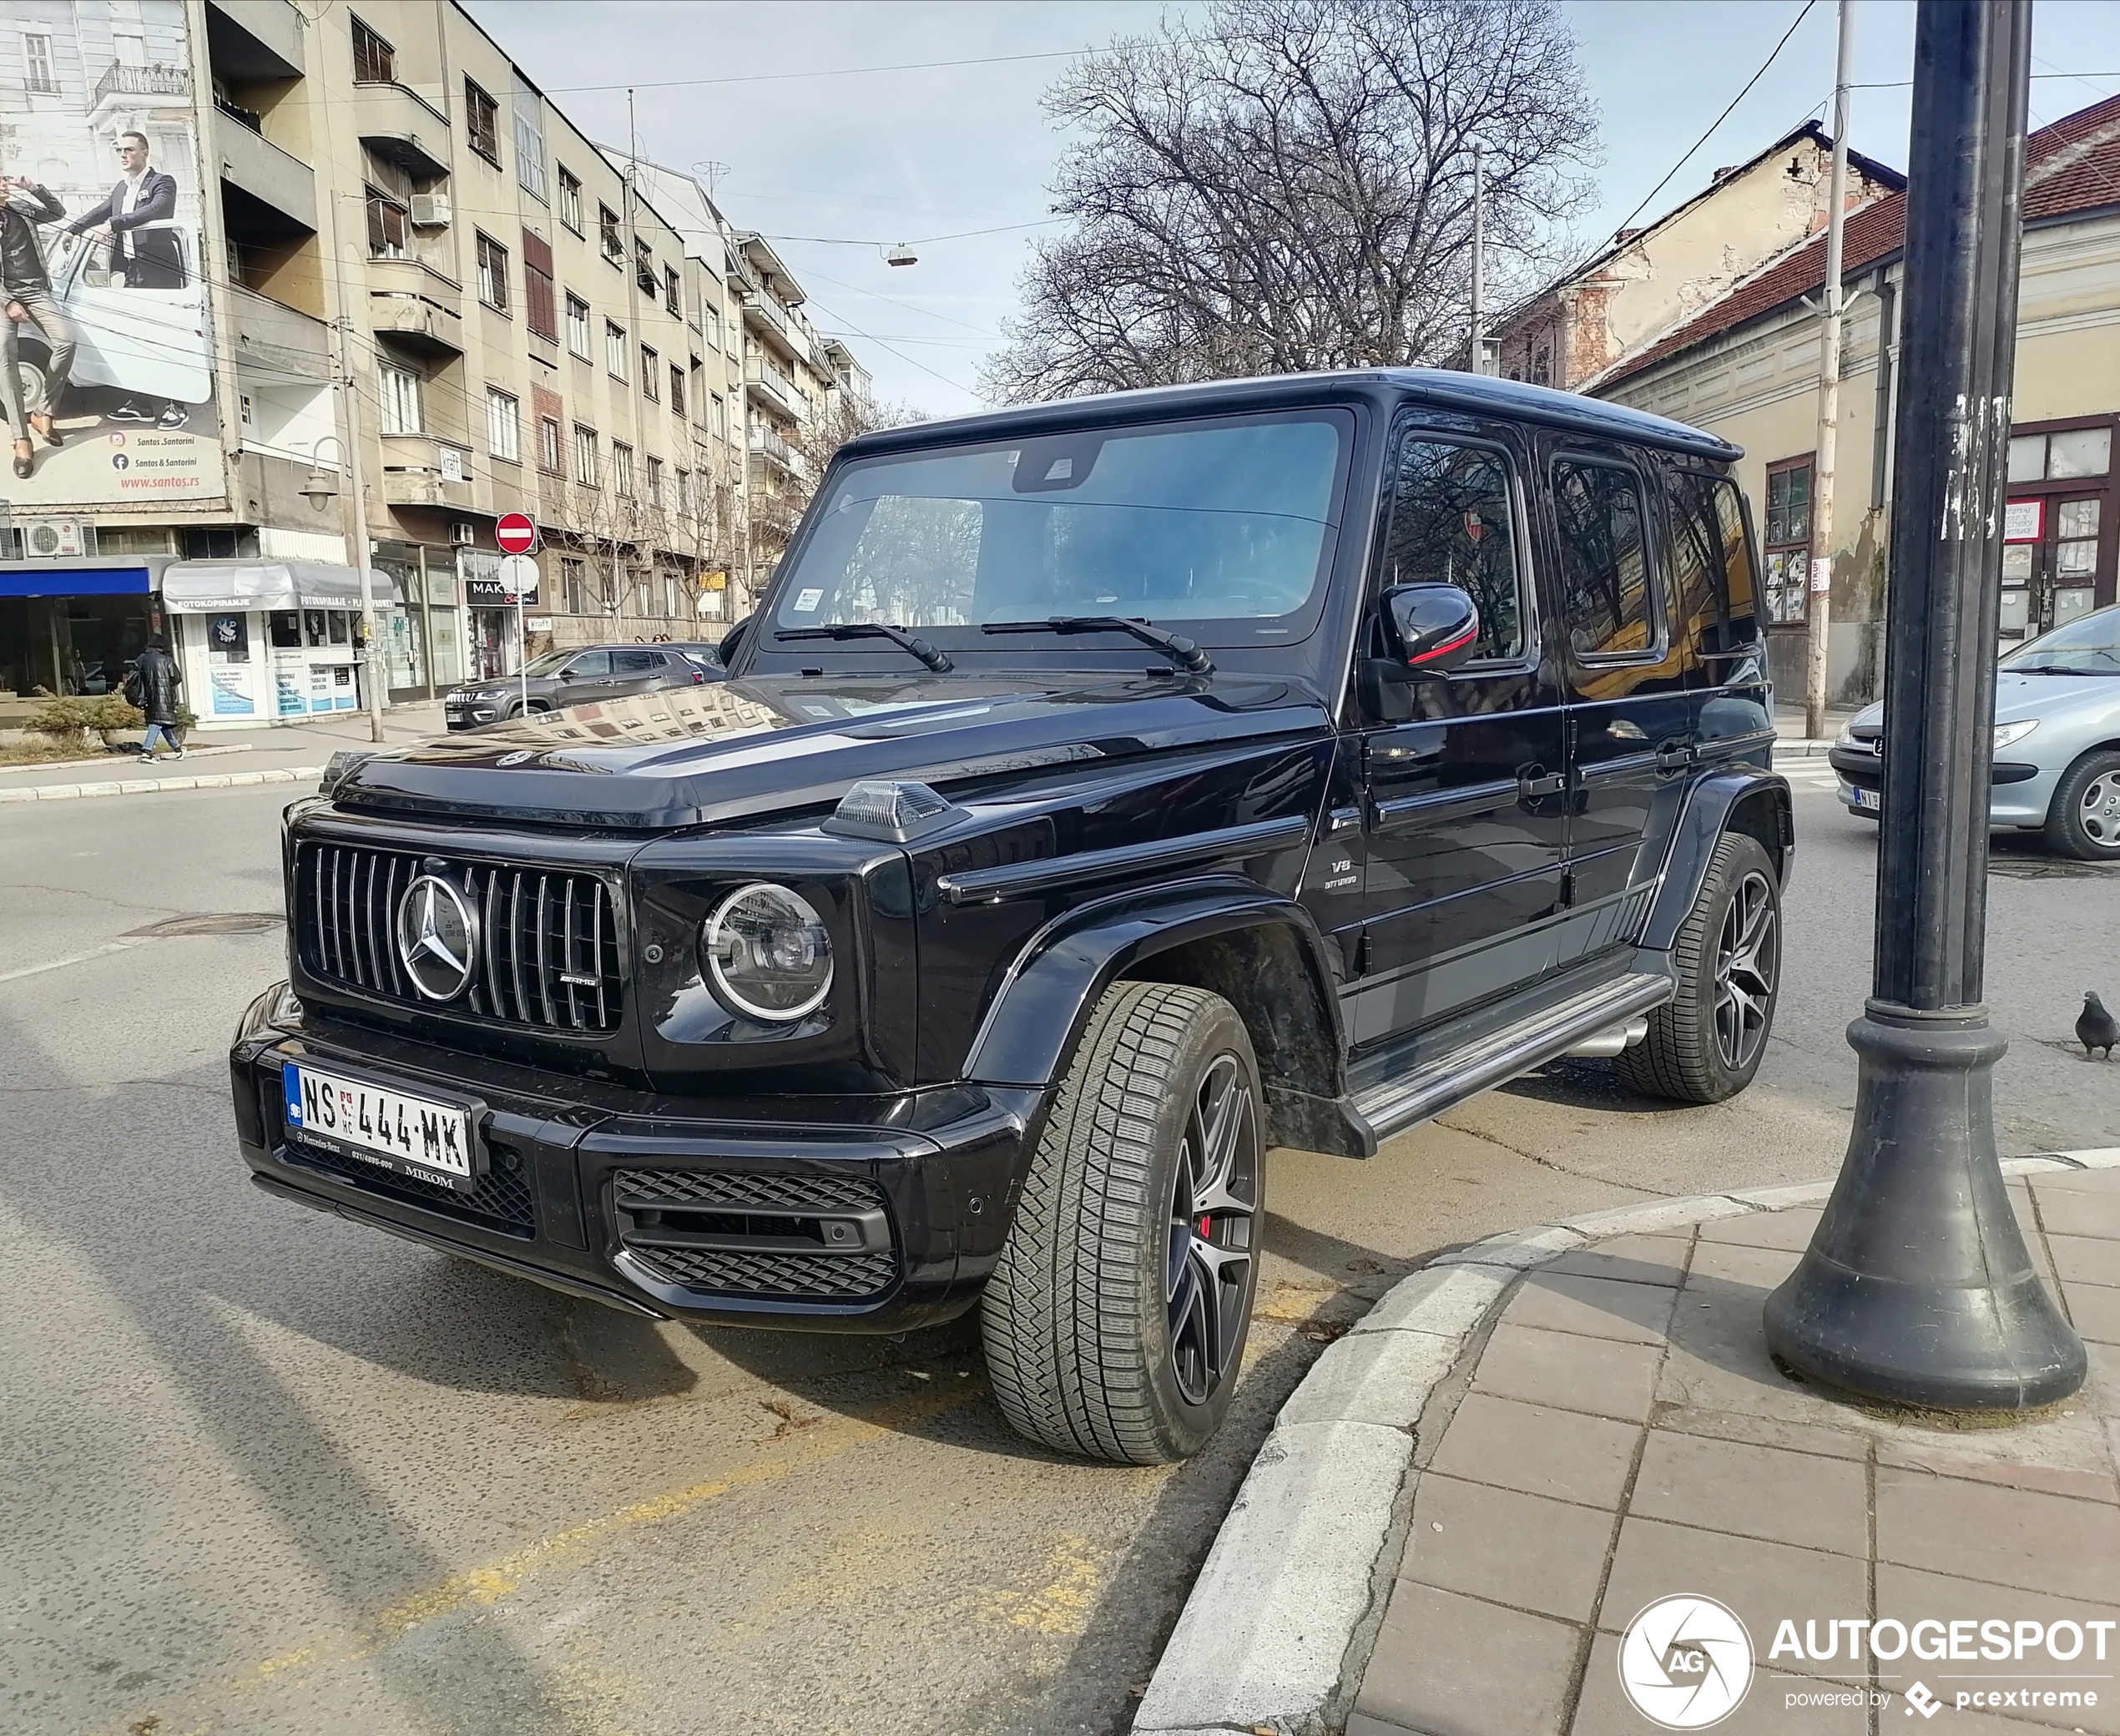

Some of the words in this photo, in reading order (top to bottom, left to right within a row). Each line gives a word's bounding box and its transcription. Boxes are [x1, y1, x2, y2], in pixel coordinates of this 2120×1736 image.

[137, 437, 160, 447] Santos
[135, 459, 158, 467] Santos
[159, 458, 164, 467] &
[165, 457, 197, 467] Santorini
[121, 476, 200, 489] www.santos.rs
[177, 598, 250, 608] FOTOKOPIRANJE
[300, 596, 346, 606] FOTOKOPIRANJE
[1331, 860, 1350, 874] V8
[1325, 876, 1357, 890] BITURBO
[571, 977, 596, 986] AMG
[303, 1076, 336, 1128] NS
[359, 1093, 463, 1168] 444-MK
[303, 1133, 341, 1153] Mercedes-Benz
[404, 1164, 455, 1189] MIKOM
